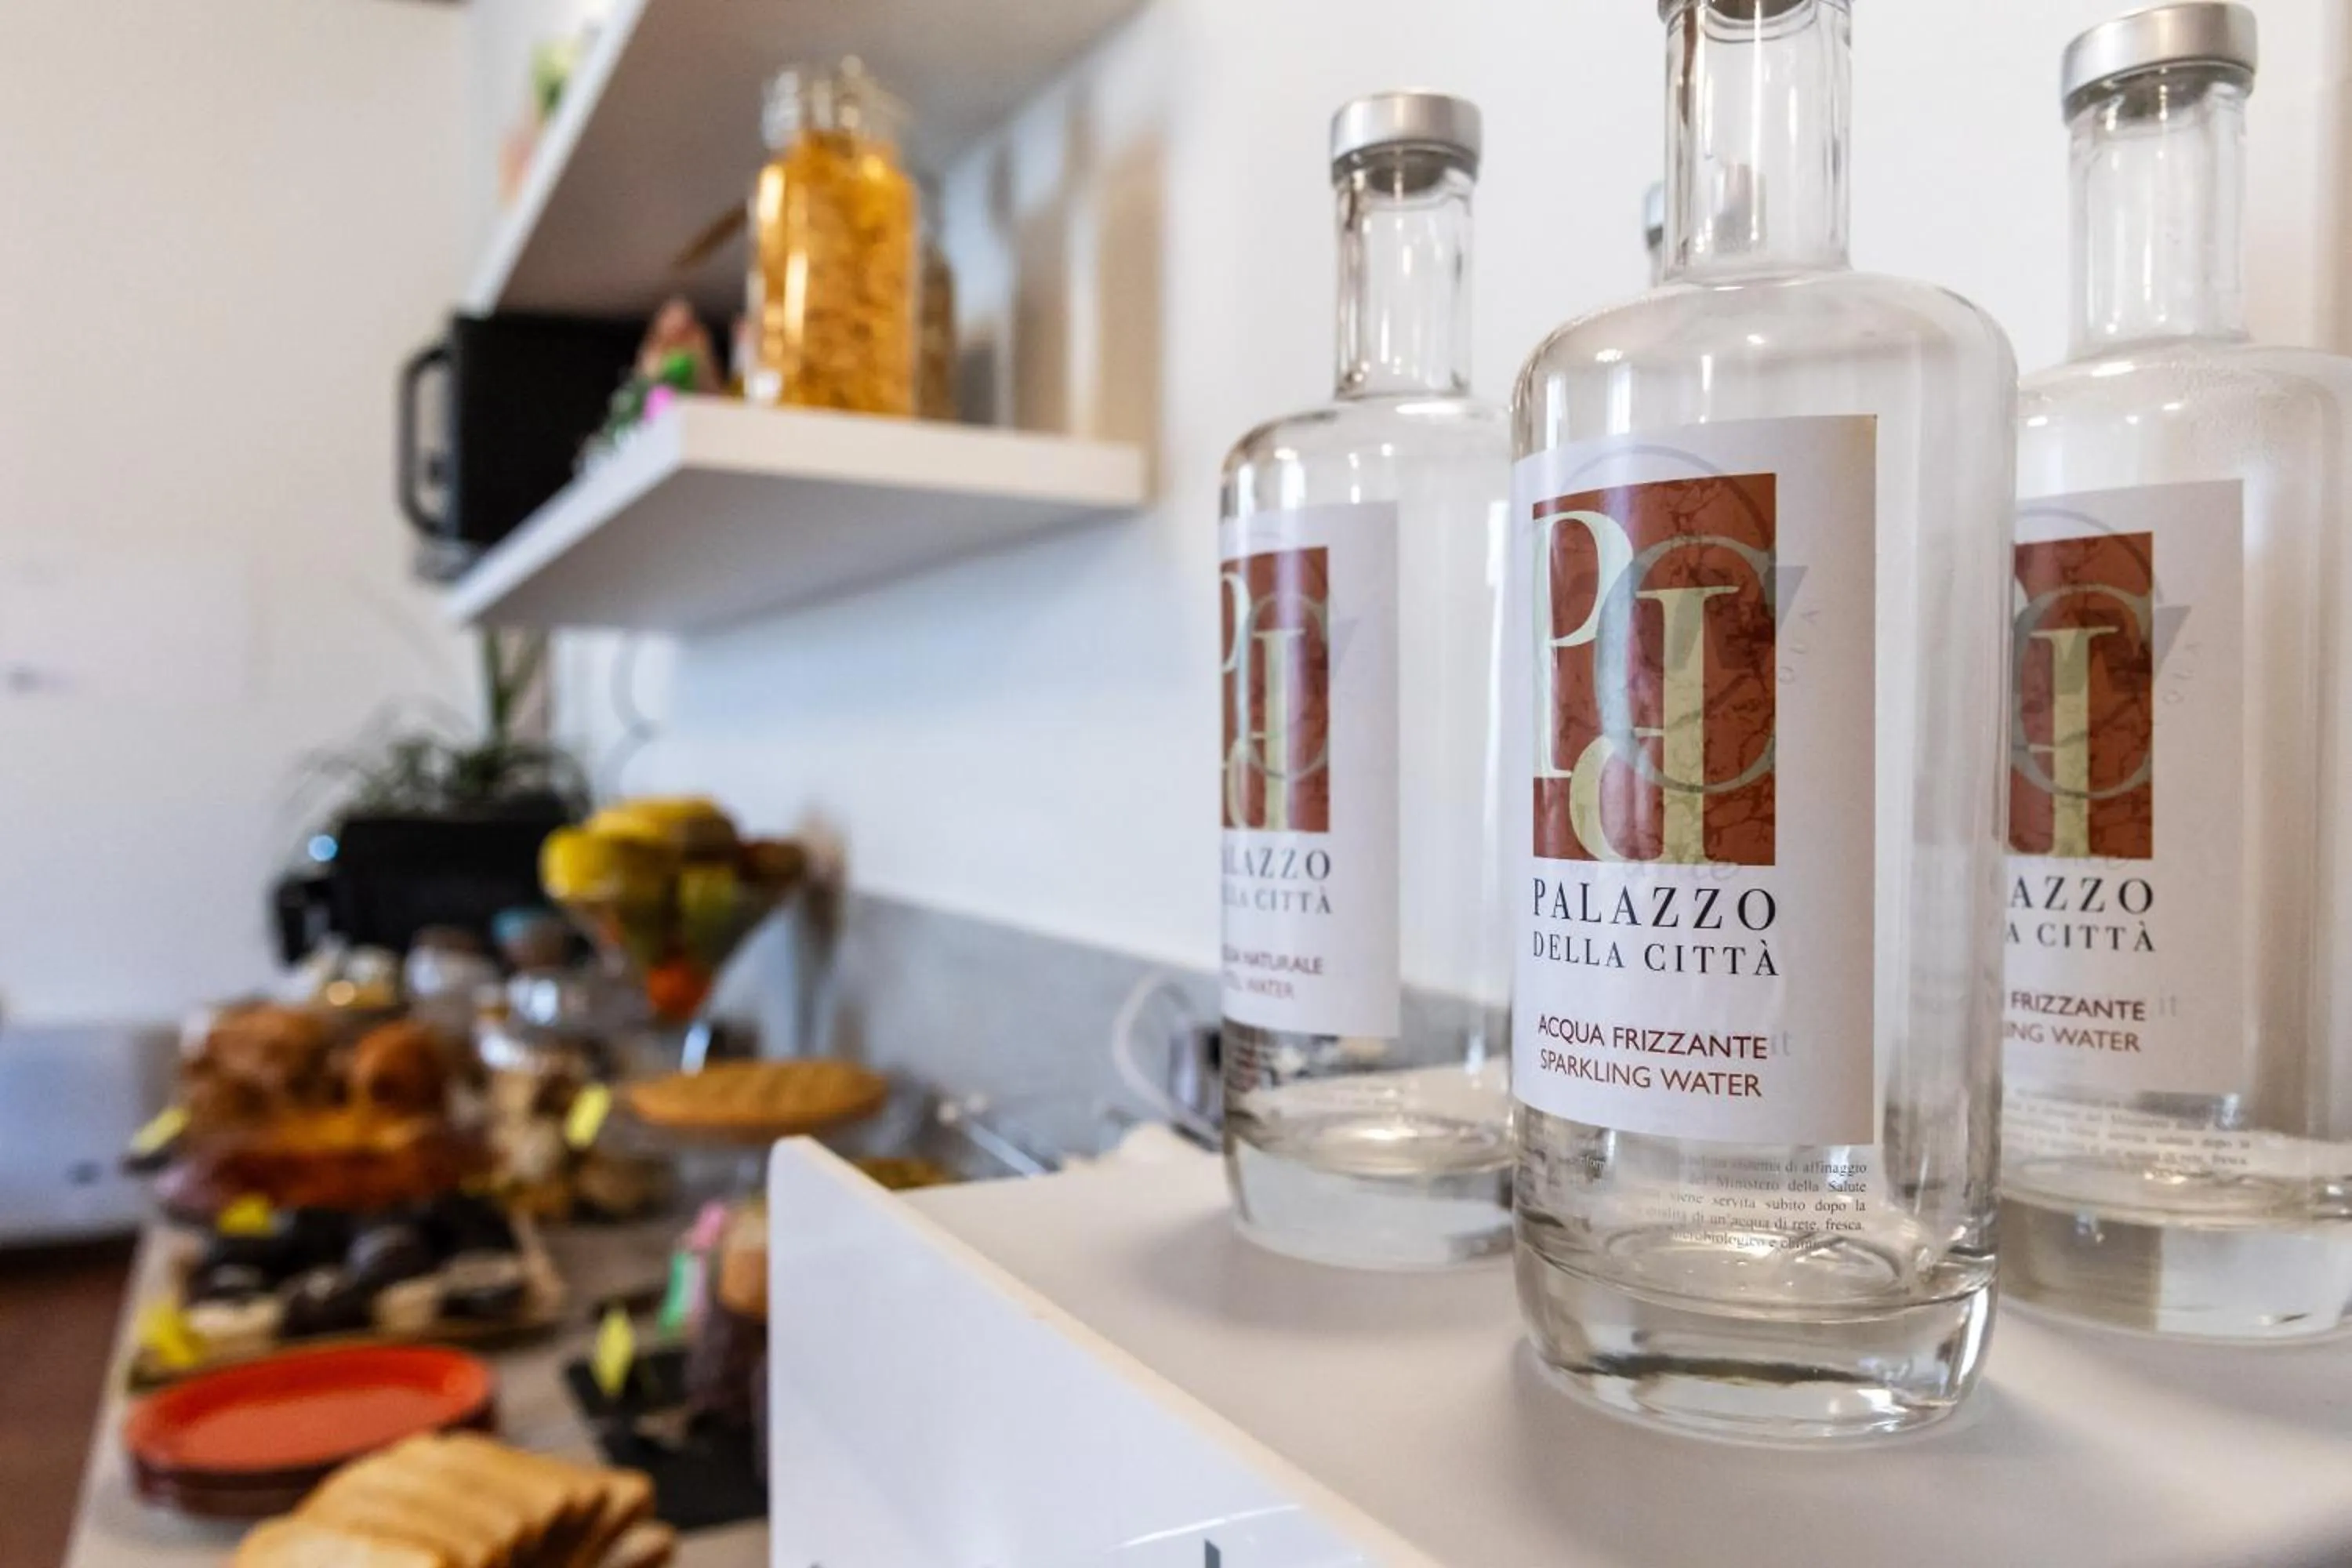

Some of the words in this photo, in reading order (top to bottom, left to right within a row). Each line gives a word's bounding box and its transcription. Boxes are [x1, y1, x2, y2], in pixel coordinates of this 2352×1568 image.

[1255, 885, 1334, 914] CITTÀ
[1534, 877, 1777, 931] PALAZZO
[2036, 920, 2157, 953] CITTÀ
[1534, 931, 1625, 969] DELLA
[1644, 939, 1779, 976] CITTÀ
[2011, 990, 2147, 1022] FRIZZANTE
[1538, 1014, 1605, 1047] ACQUA
[1613, 1026, 1768, 1059] FRIZZANTE
[2051, 1025, 2142, 1054] WATER
[1540, 1048, 1651, 1088] SPARKLING
[1661, 1069, 1762, 1097] WATER
[1802, 1160, 1867, 1177] affinaggio
[1788, 1178, 1820, 1192] della
[1828, 1180, 1867, 1192] Salute
[1765, 1197, 1806, 1212] subito
[1815, 1199, 1847, 1214] dopo
[1855, 1199, 1867, 1212] la
[1774, 1216, 1788, 1229] di
